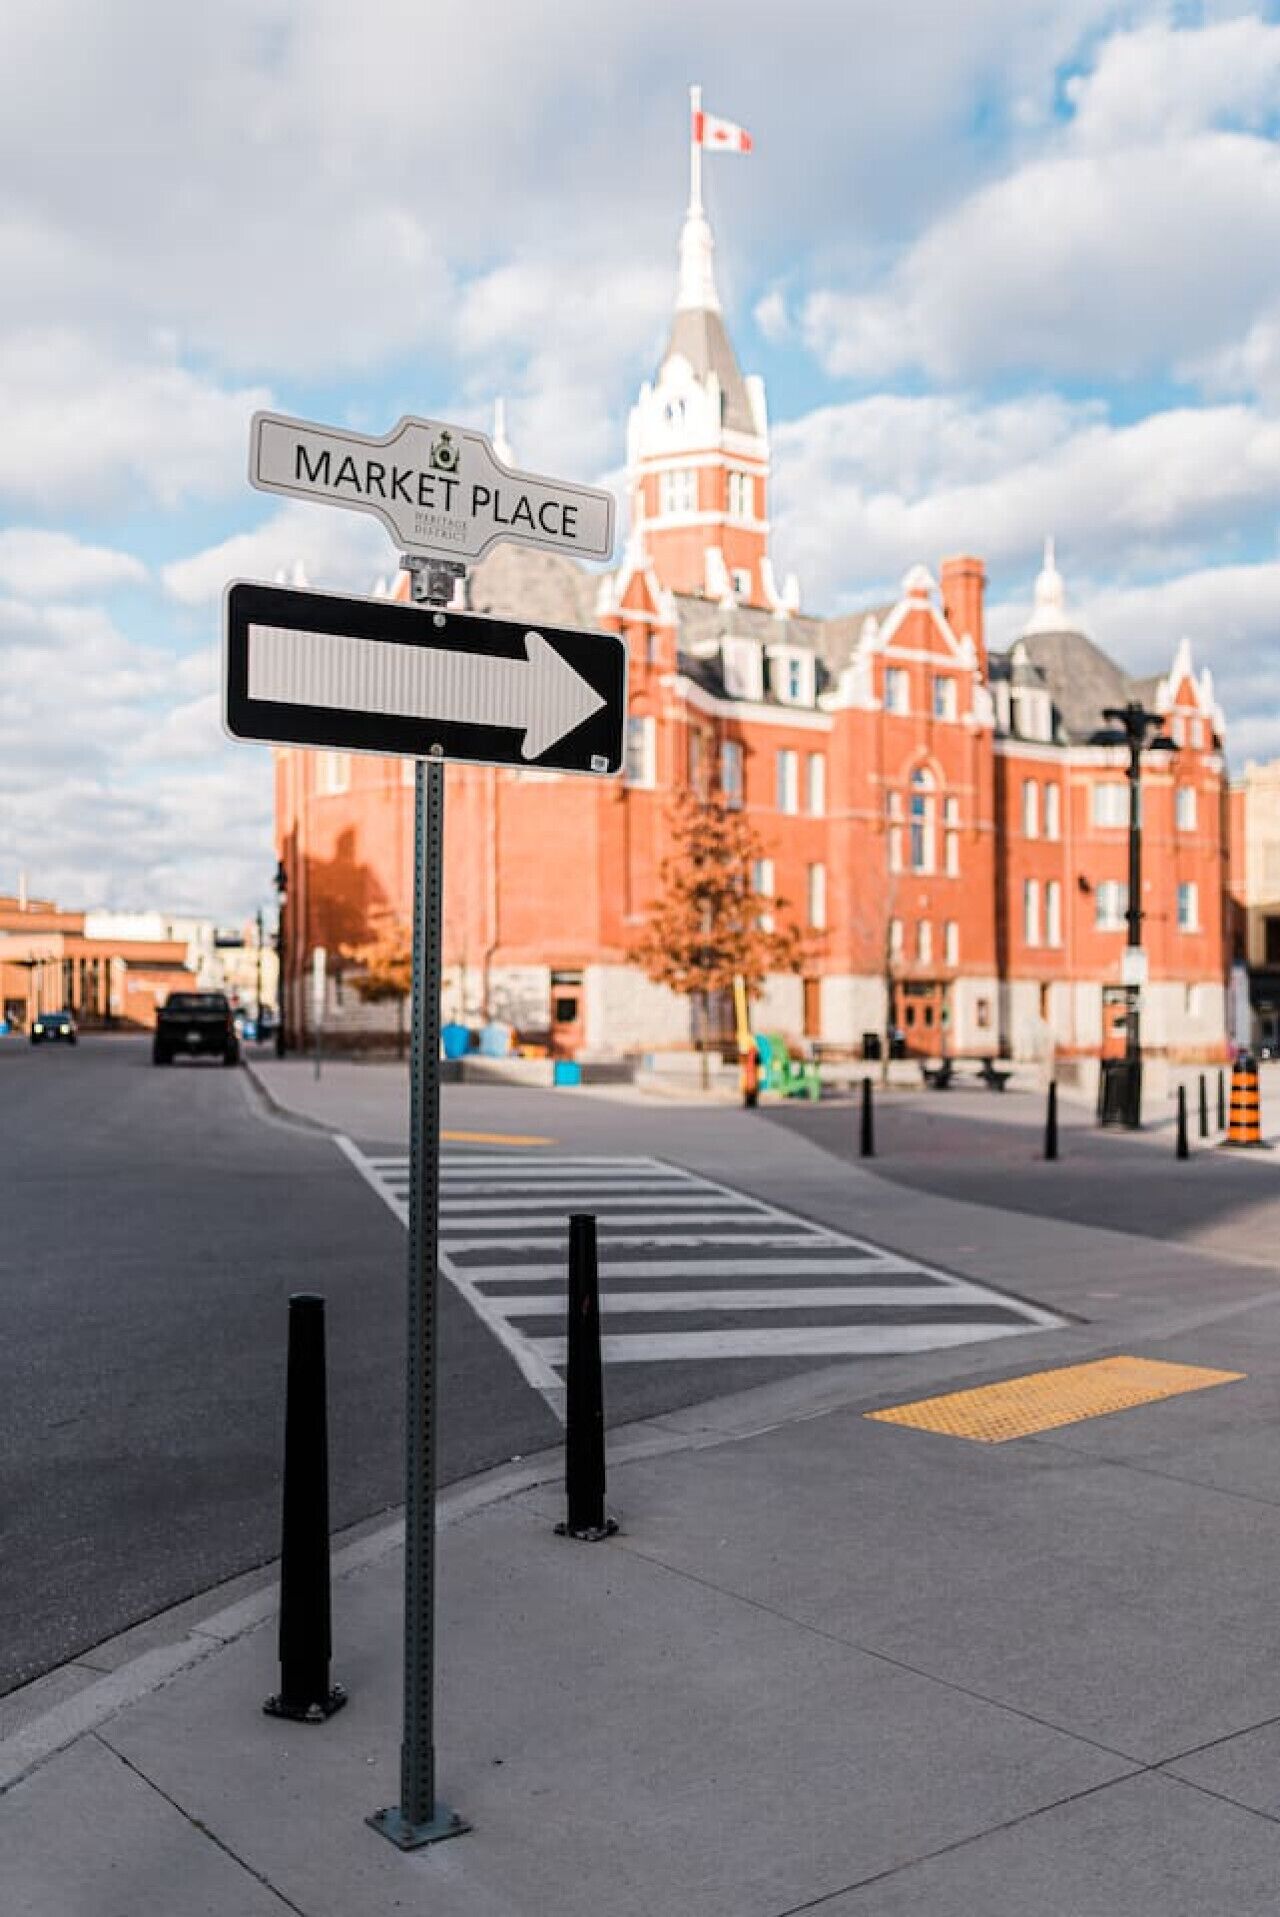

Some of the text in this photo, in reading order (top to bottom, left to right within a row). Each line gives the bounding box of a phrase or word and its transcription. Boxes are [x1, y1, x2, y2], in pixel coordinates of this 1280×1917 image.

[295, 445, 578, 537] MARKET PLACE
[415, 511, 467, 529] HERITAGE
[415, 525, 466, 542] DISTRICT
